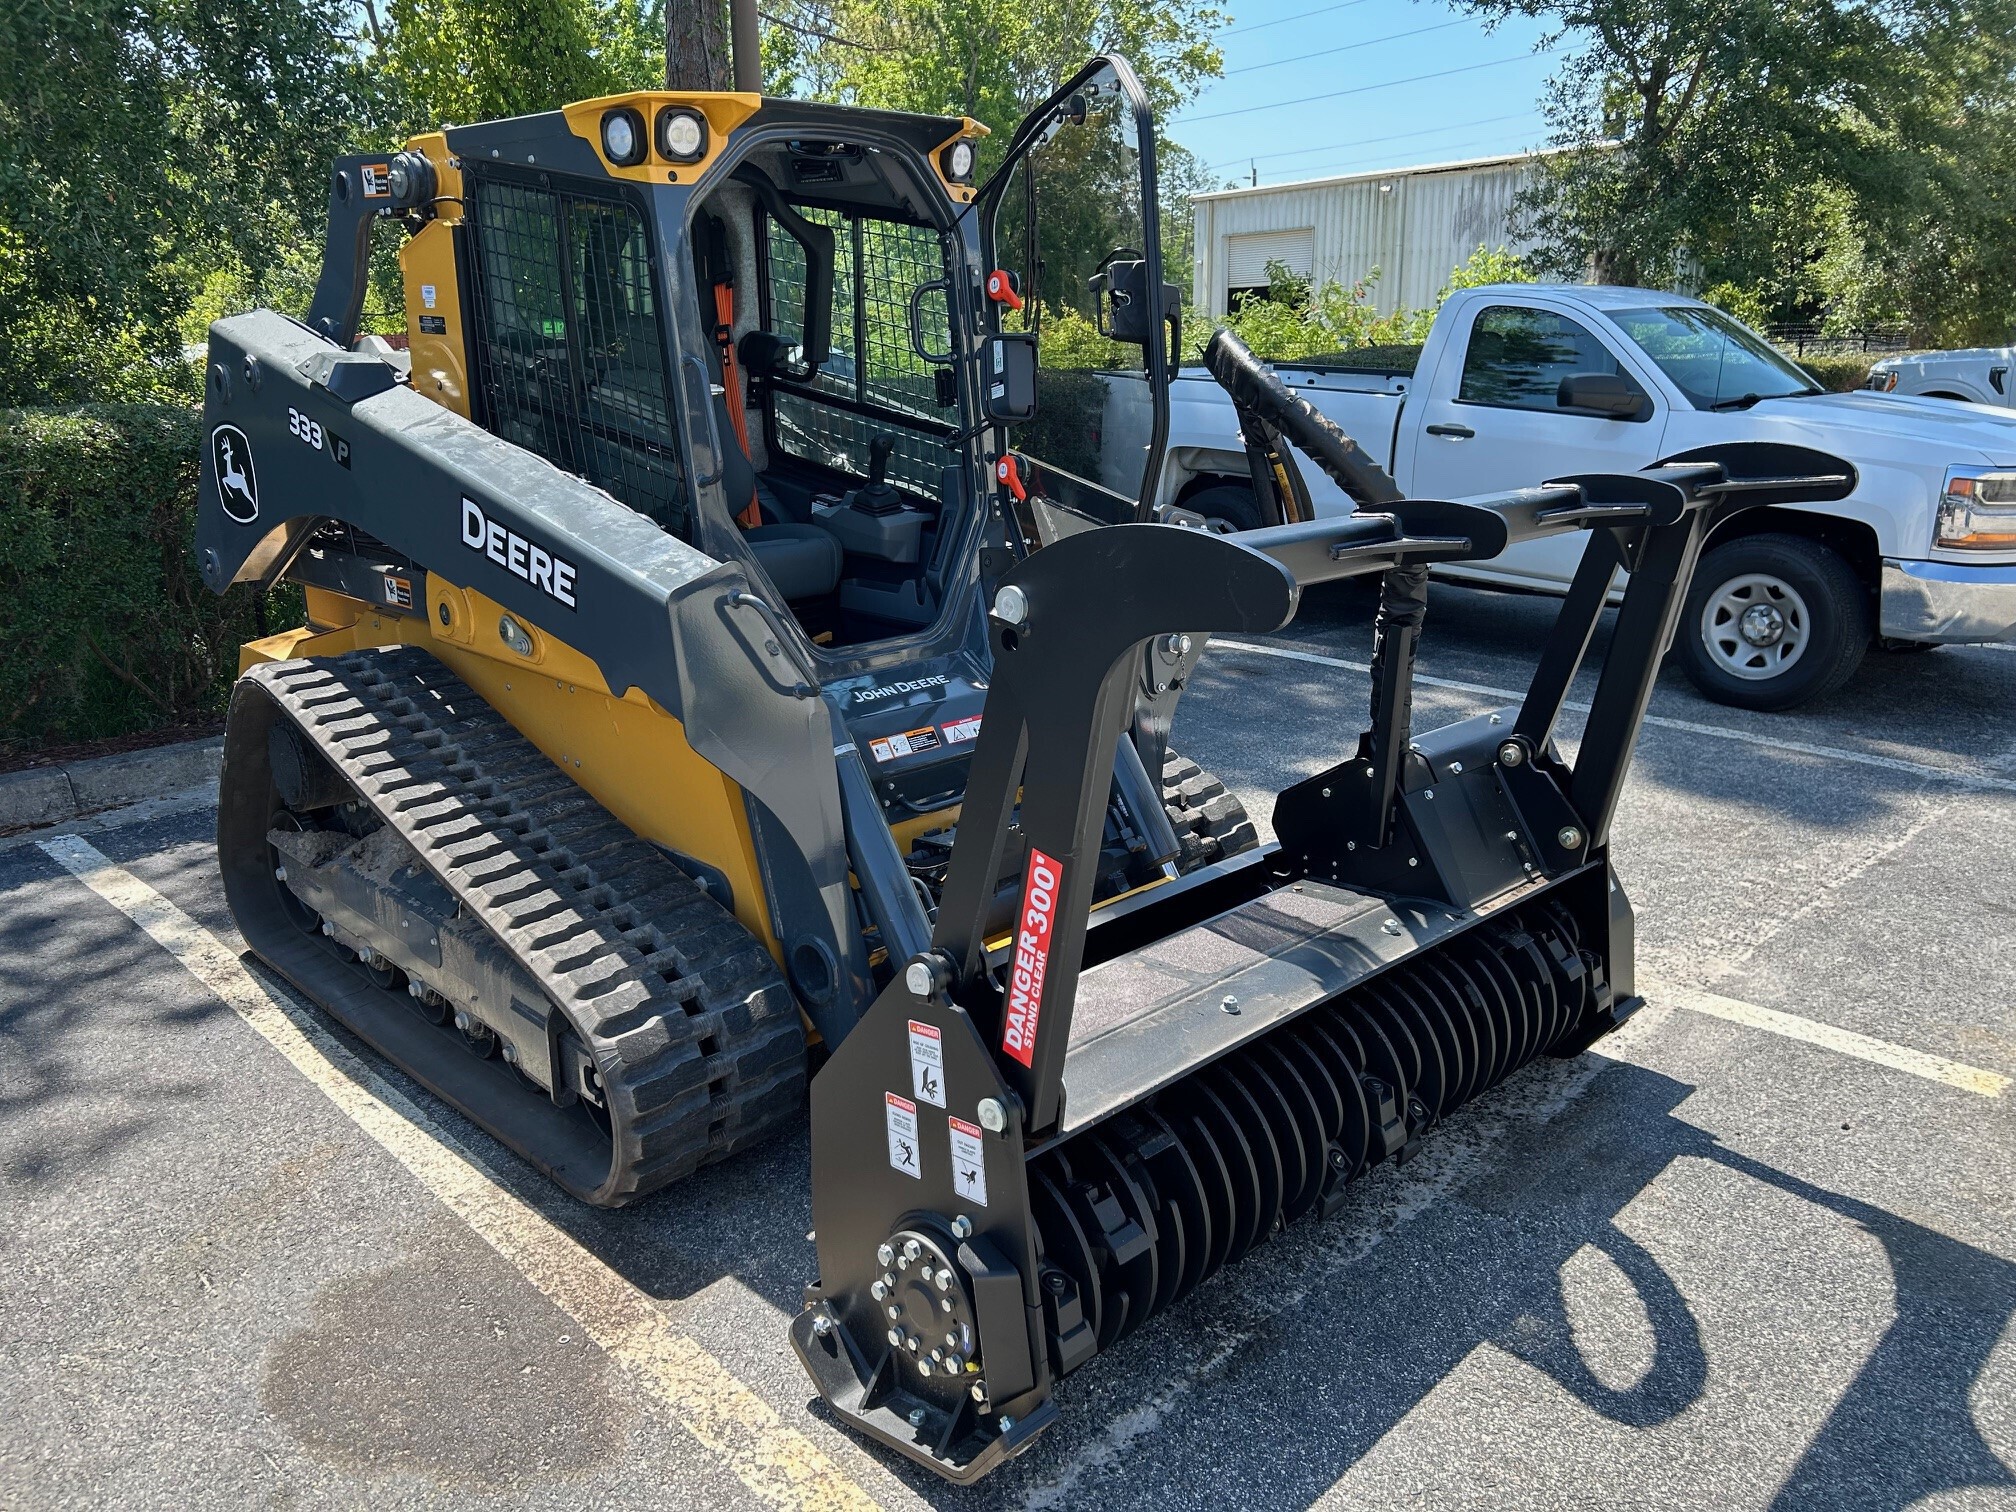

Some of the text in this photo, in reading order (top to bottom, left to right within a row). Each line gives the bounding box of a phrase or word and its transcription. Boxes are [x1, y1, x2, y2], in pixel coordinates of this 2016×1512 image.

[288, 407, 349, 462] 333 P
[462, 497, 576, 608] DEERE
[854, 674, 950, 703] JOHN DEERE
[1005, 855, 1055, 1051] DANGER 300'
[1023, 952, 1046, 1049] STAND CLEAR
[916, 1025, 939, 1039] DANGER
[893, 1097, 915, 1113] DANGER
[956, 1121, 980, 1137] DANGER
